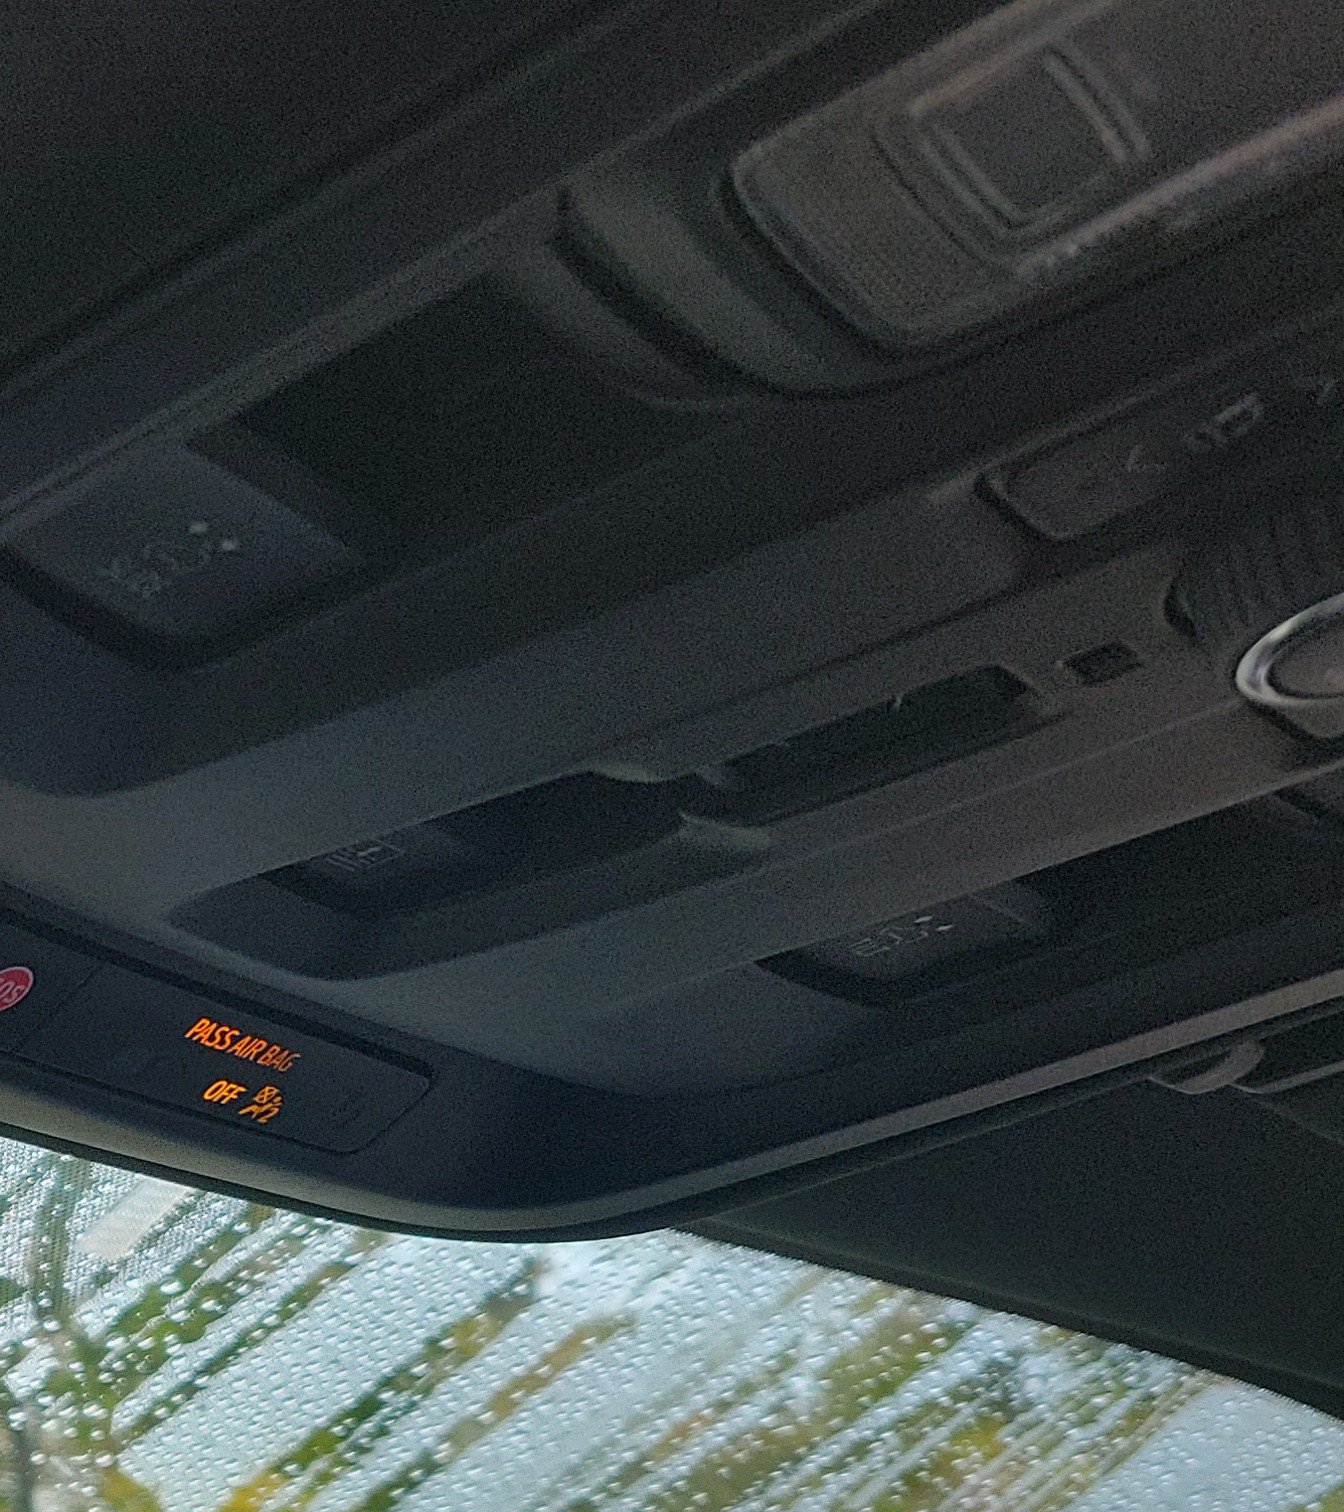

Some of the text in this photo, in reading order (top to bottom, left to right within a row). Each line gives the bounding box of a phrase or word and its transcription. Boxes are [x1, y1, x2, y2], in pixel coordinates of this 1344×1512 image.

[184, 1017, 302, 1072] PASS AIR BAG
[202, 1079, 248, 1104] OFF
